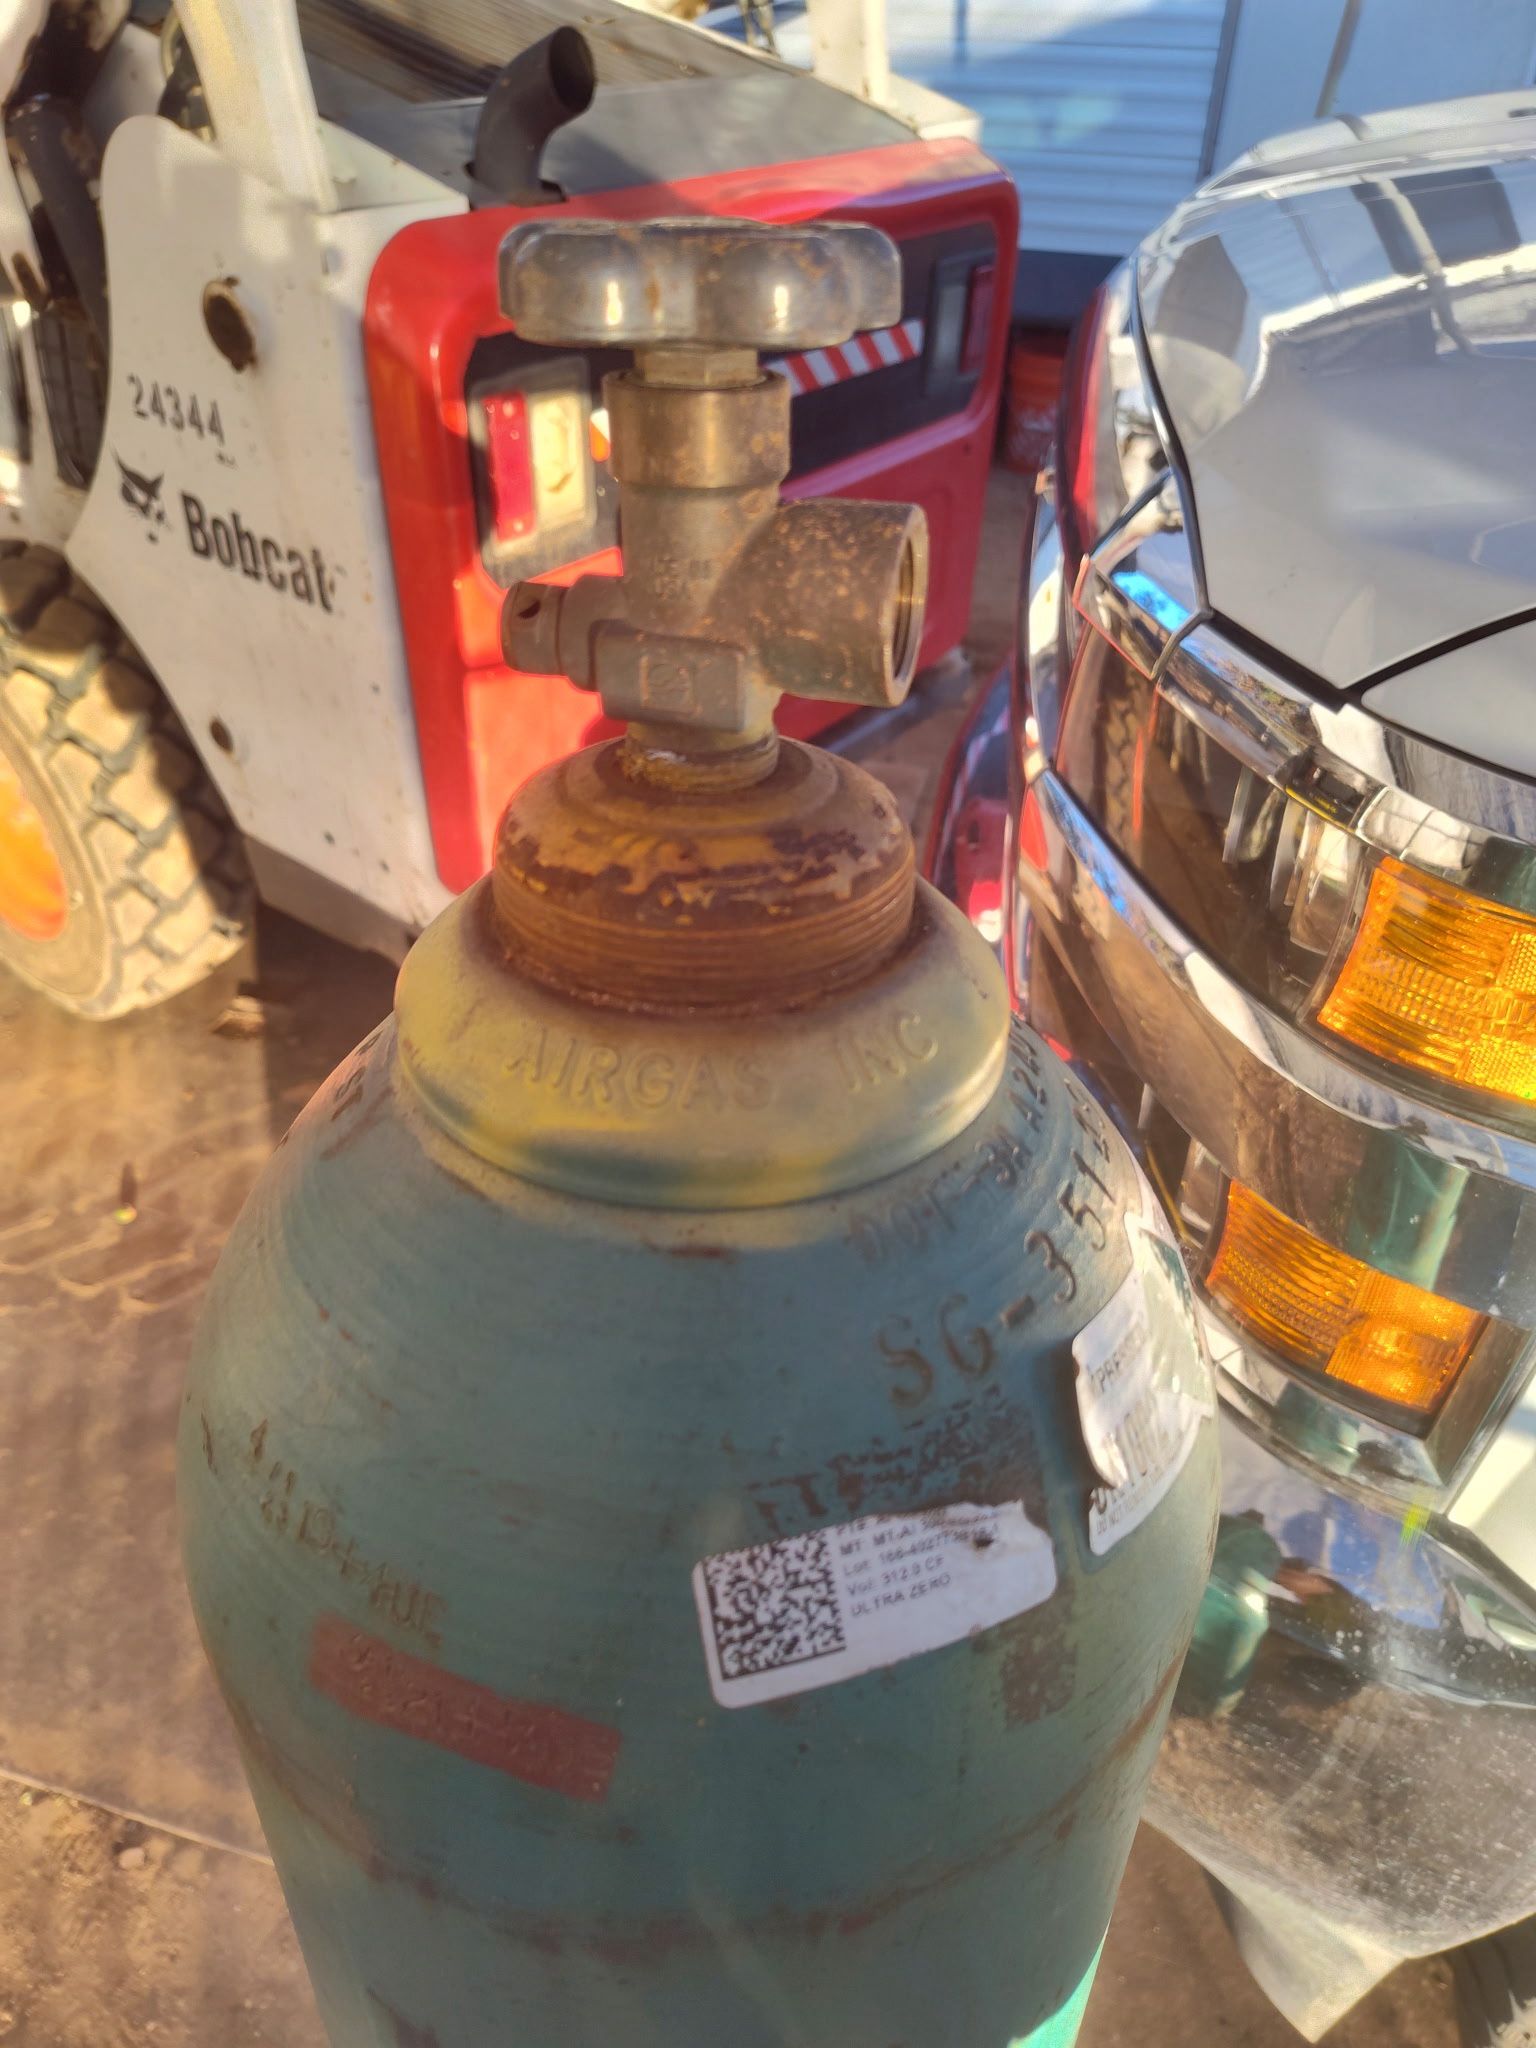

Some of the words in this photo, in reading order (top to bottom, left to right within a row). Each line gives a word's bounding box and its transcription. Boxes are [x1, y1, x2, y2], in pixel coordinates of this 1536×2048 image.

[127, 373, 225, 446] 24344
[179, 489, 334, 615] Bobcat
[506, 1022, 776, 1111] AIRGAS
[831, 1008, 940, 1093] INC
[852, 1590, 905, 1618] ULTRA
[909, 1572, 952, 1600] ZERO
